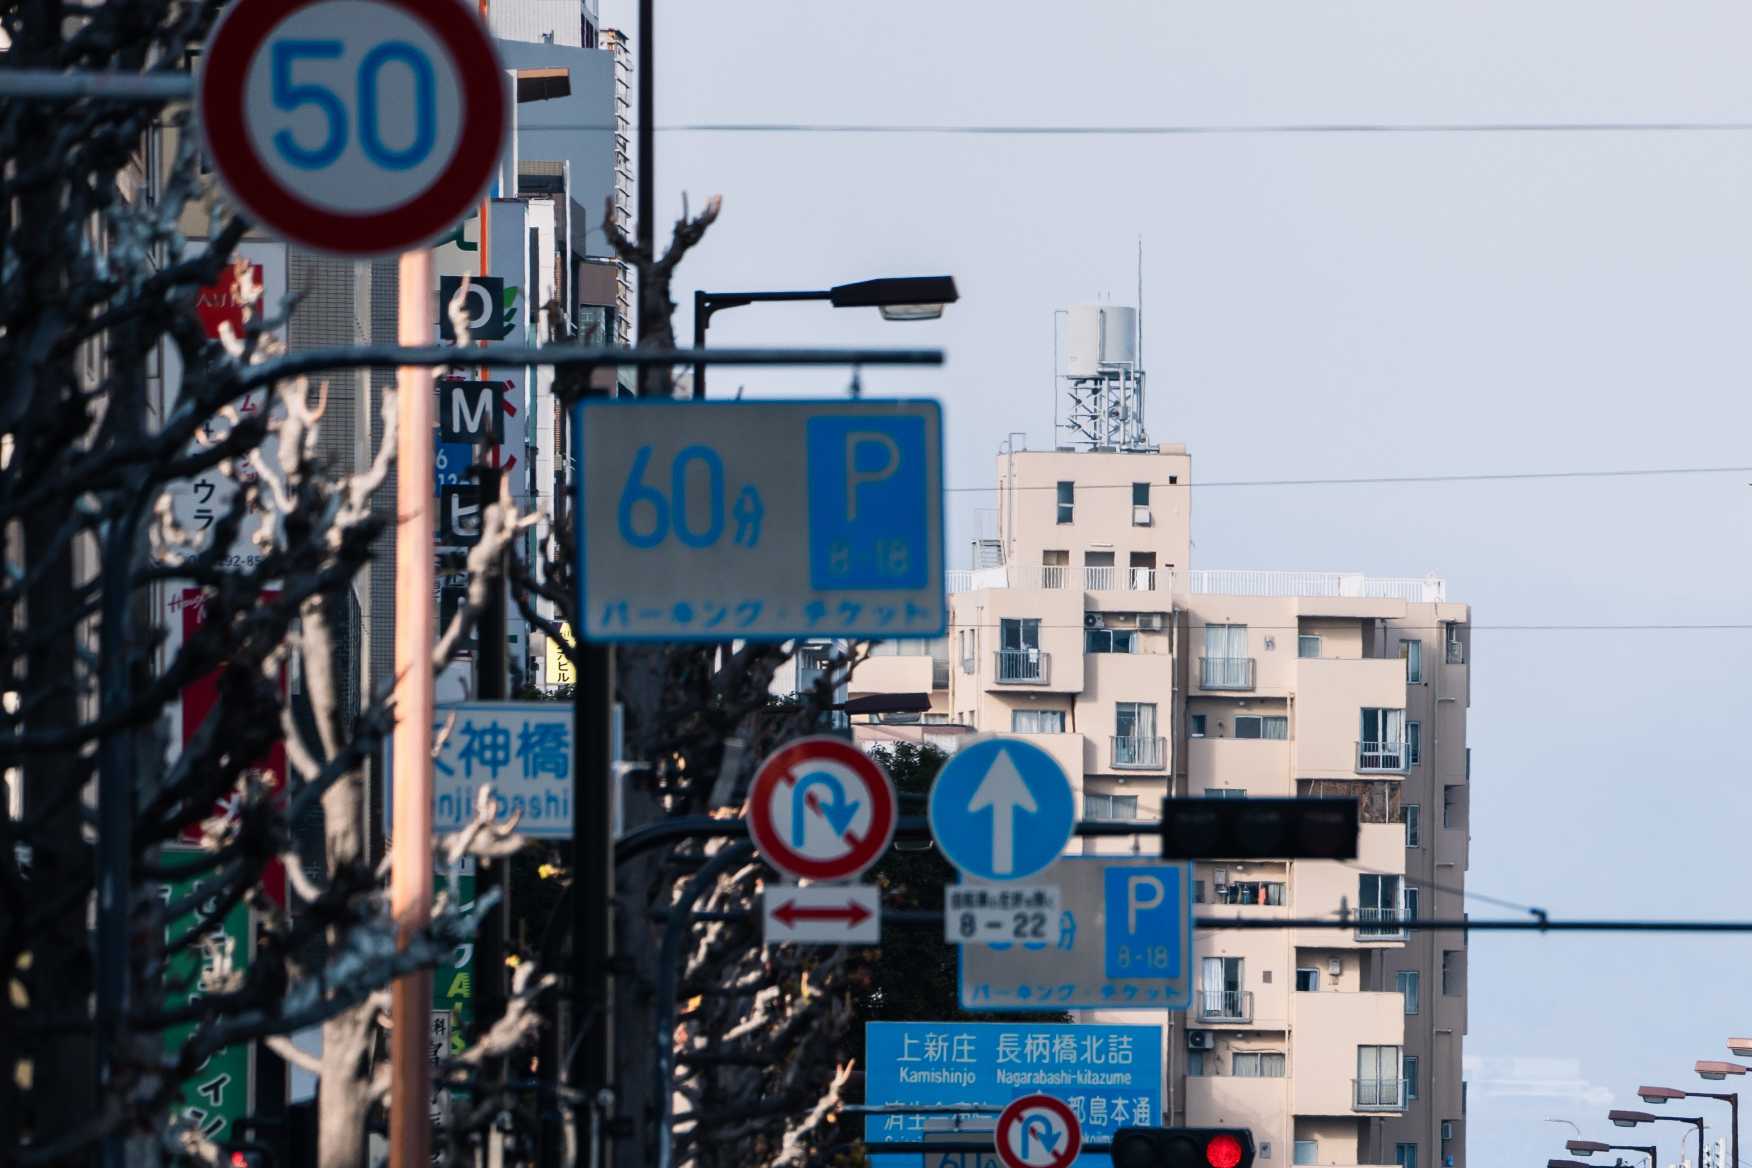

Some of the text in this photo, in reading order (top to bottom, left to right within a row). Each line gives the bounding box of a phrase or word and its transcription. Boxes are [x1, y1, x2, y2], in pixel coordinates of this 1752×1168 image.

[271, 38, 439, 171] 50
[617, 444, 765, 551] 60分
[845, 431, 901, 523] P
[432, 719, 569, 780] 神橋
[1128, 875, 1165, 935] P
[897, 1032, 1133, 1065] 上新庄 長柄橋北詰
[900, 1066, 1132, 1088] Kamishinjo Nagarabashi-kitazume
[1067, 1096, 1150, 1127] 都島本通
